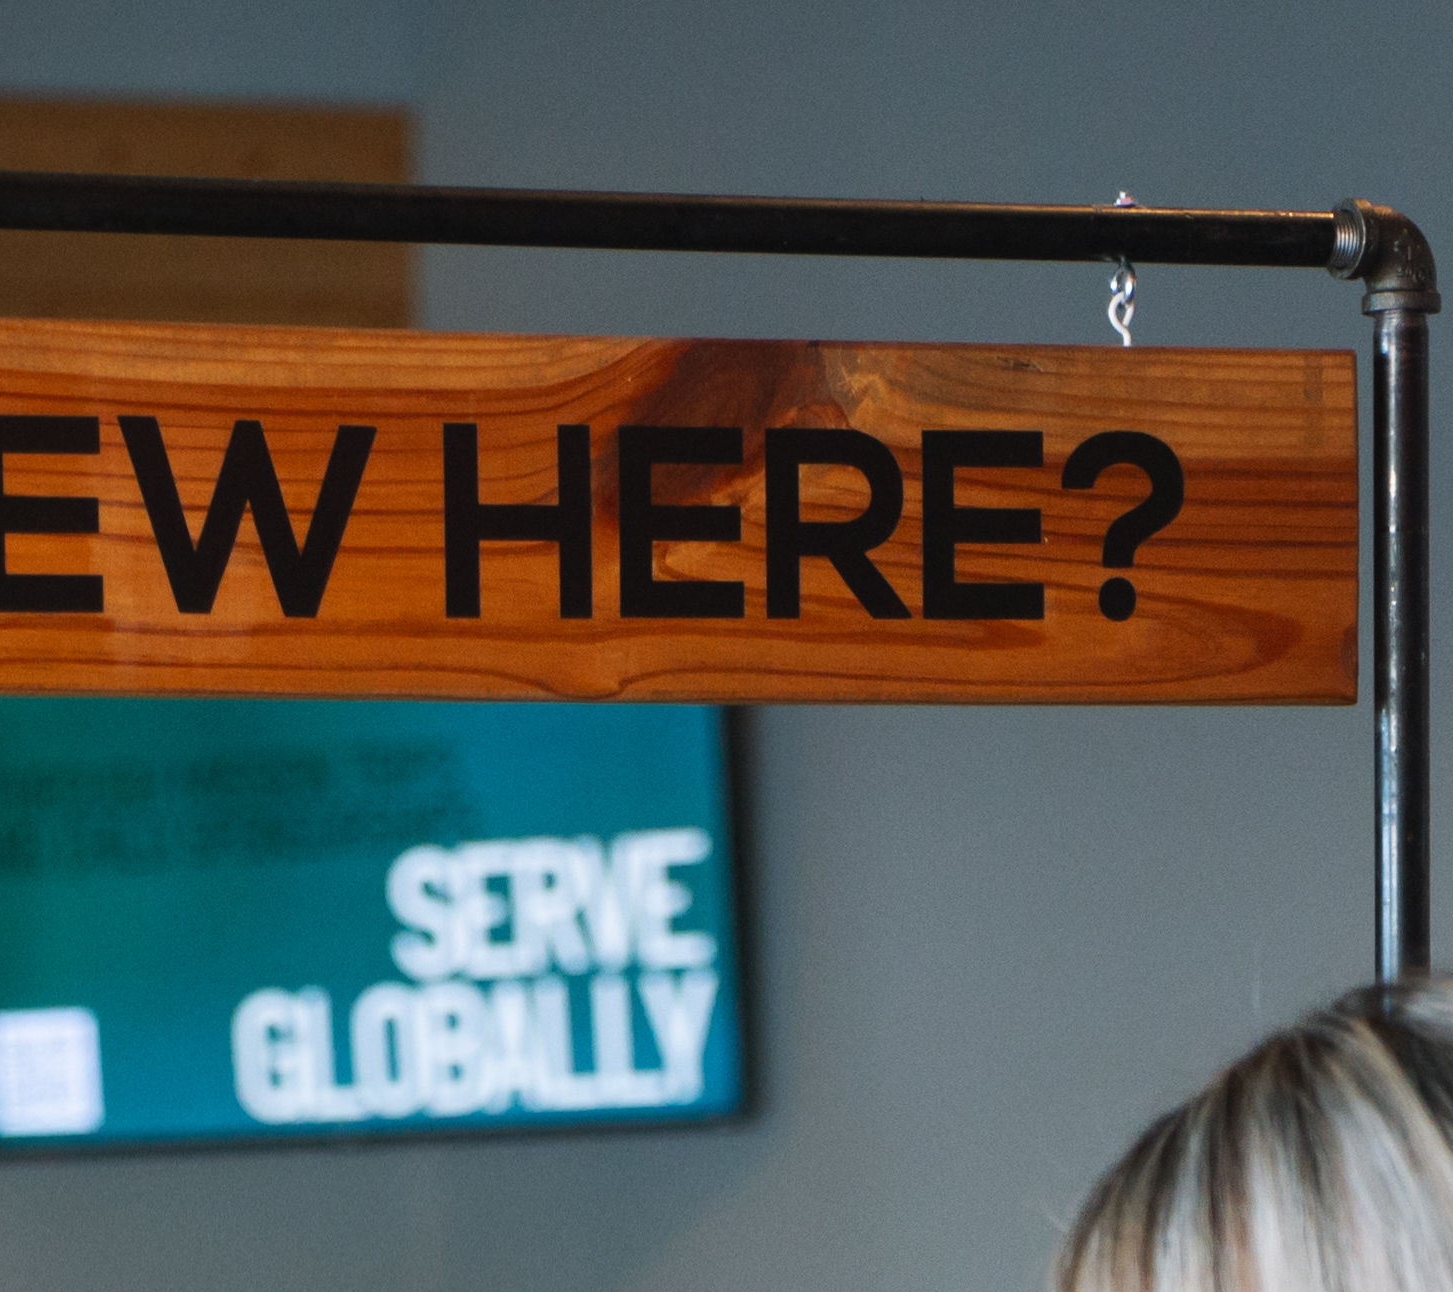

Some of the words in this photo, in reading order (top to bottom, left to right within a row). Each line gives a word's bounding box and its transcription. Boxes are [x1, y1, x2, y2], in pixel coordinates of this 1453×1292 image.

[442, 421, 1186, 623] HERE?
[386, 827, 716, 982] SERVE
[231, 972, 717, 1124] GLOBALLY
